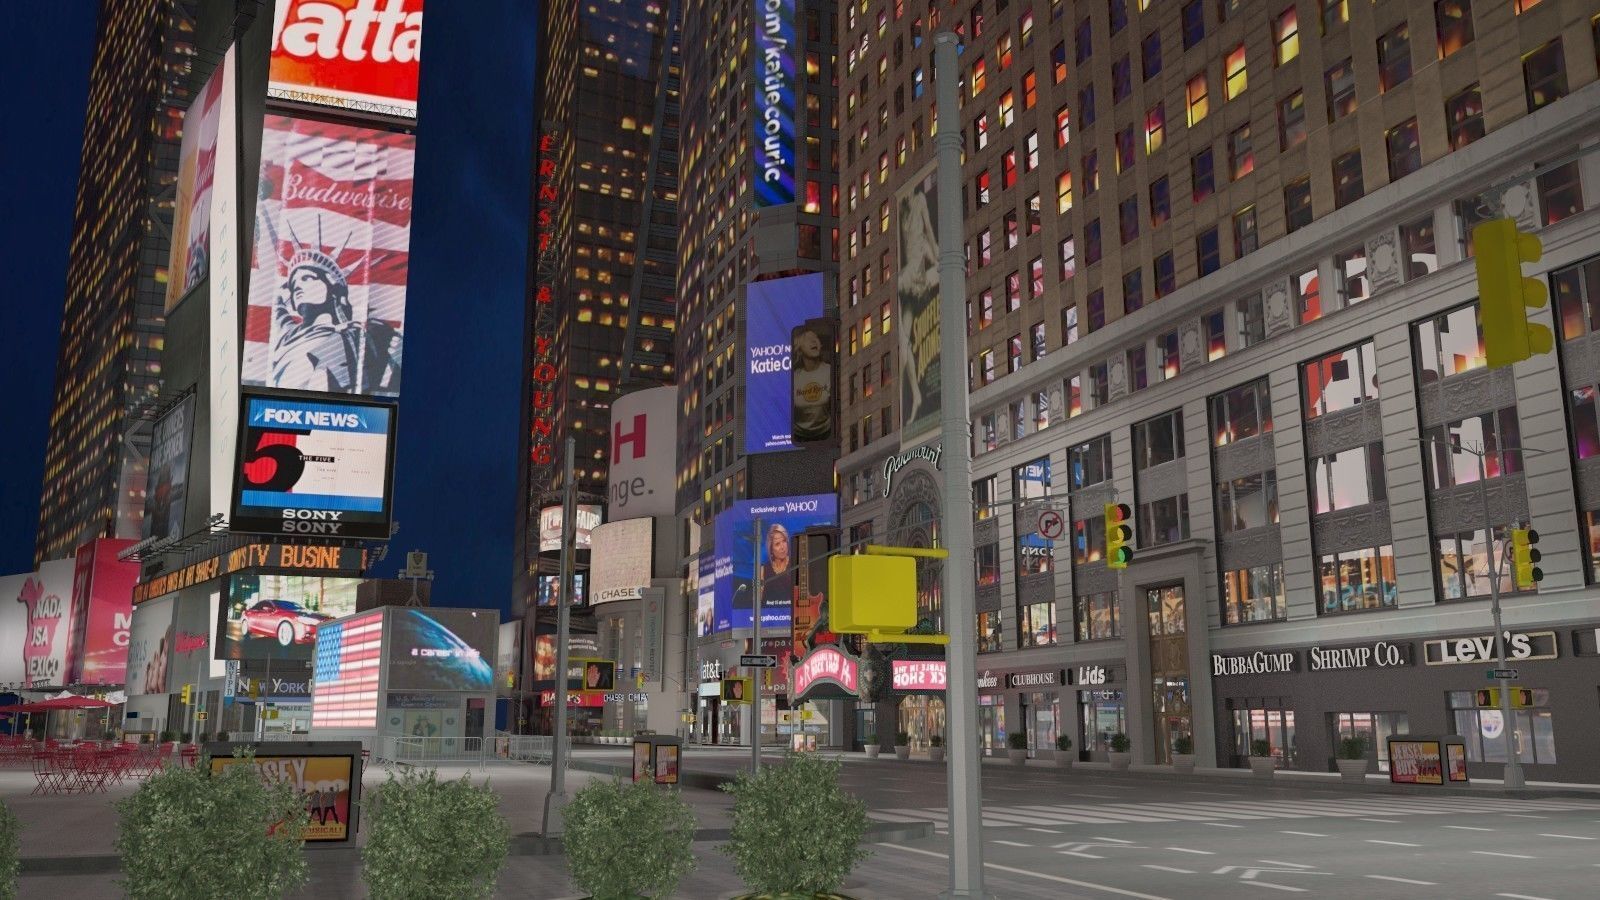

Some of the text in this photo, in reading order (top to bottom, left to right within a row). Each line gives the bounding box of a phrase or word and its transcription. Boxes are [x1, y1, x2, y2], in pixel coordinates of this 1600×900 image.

[285, 173, 412, 211] Budweise
[538, 134, 558, 251] ERNST
[750, 344, 784, 358] YAHOO!
[751, 356, 780, 374] Katie
[532, 335, 556, 465] YOUNG
[263, 408, 359, 429] FOX NEWS
[883, 443, 942, 498] Paramount
[282, 508, 342, 520] SONY
[750, 505, 778, 514] Exclusively
[785, 500, 818, 514] YAHOO!
[282, 520, 342, 534] SONY
[281, 545, 341, 569] BUSINE
[601, 587, 636, 600] CHASE
[33, 597, 62, 619] NADA
[1311, 646, 1371, 671] SHRIMP
[227, 660, 235, 696] NYPD
[702, 659, 721, 680] at&t
[977, 670, 1054, 688] nkees CLUBHOUSE
[1079, 665, 1106, 685] Lids
[238, 677, 267, 693] NW
[272, 678, 305, 693] YORK
